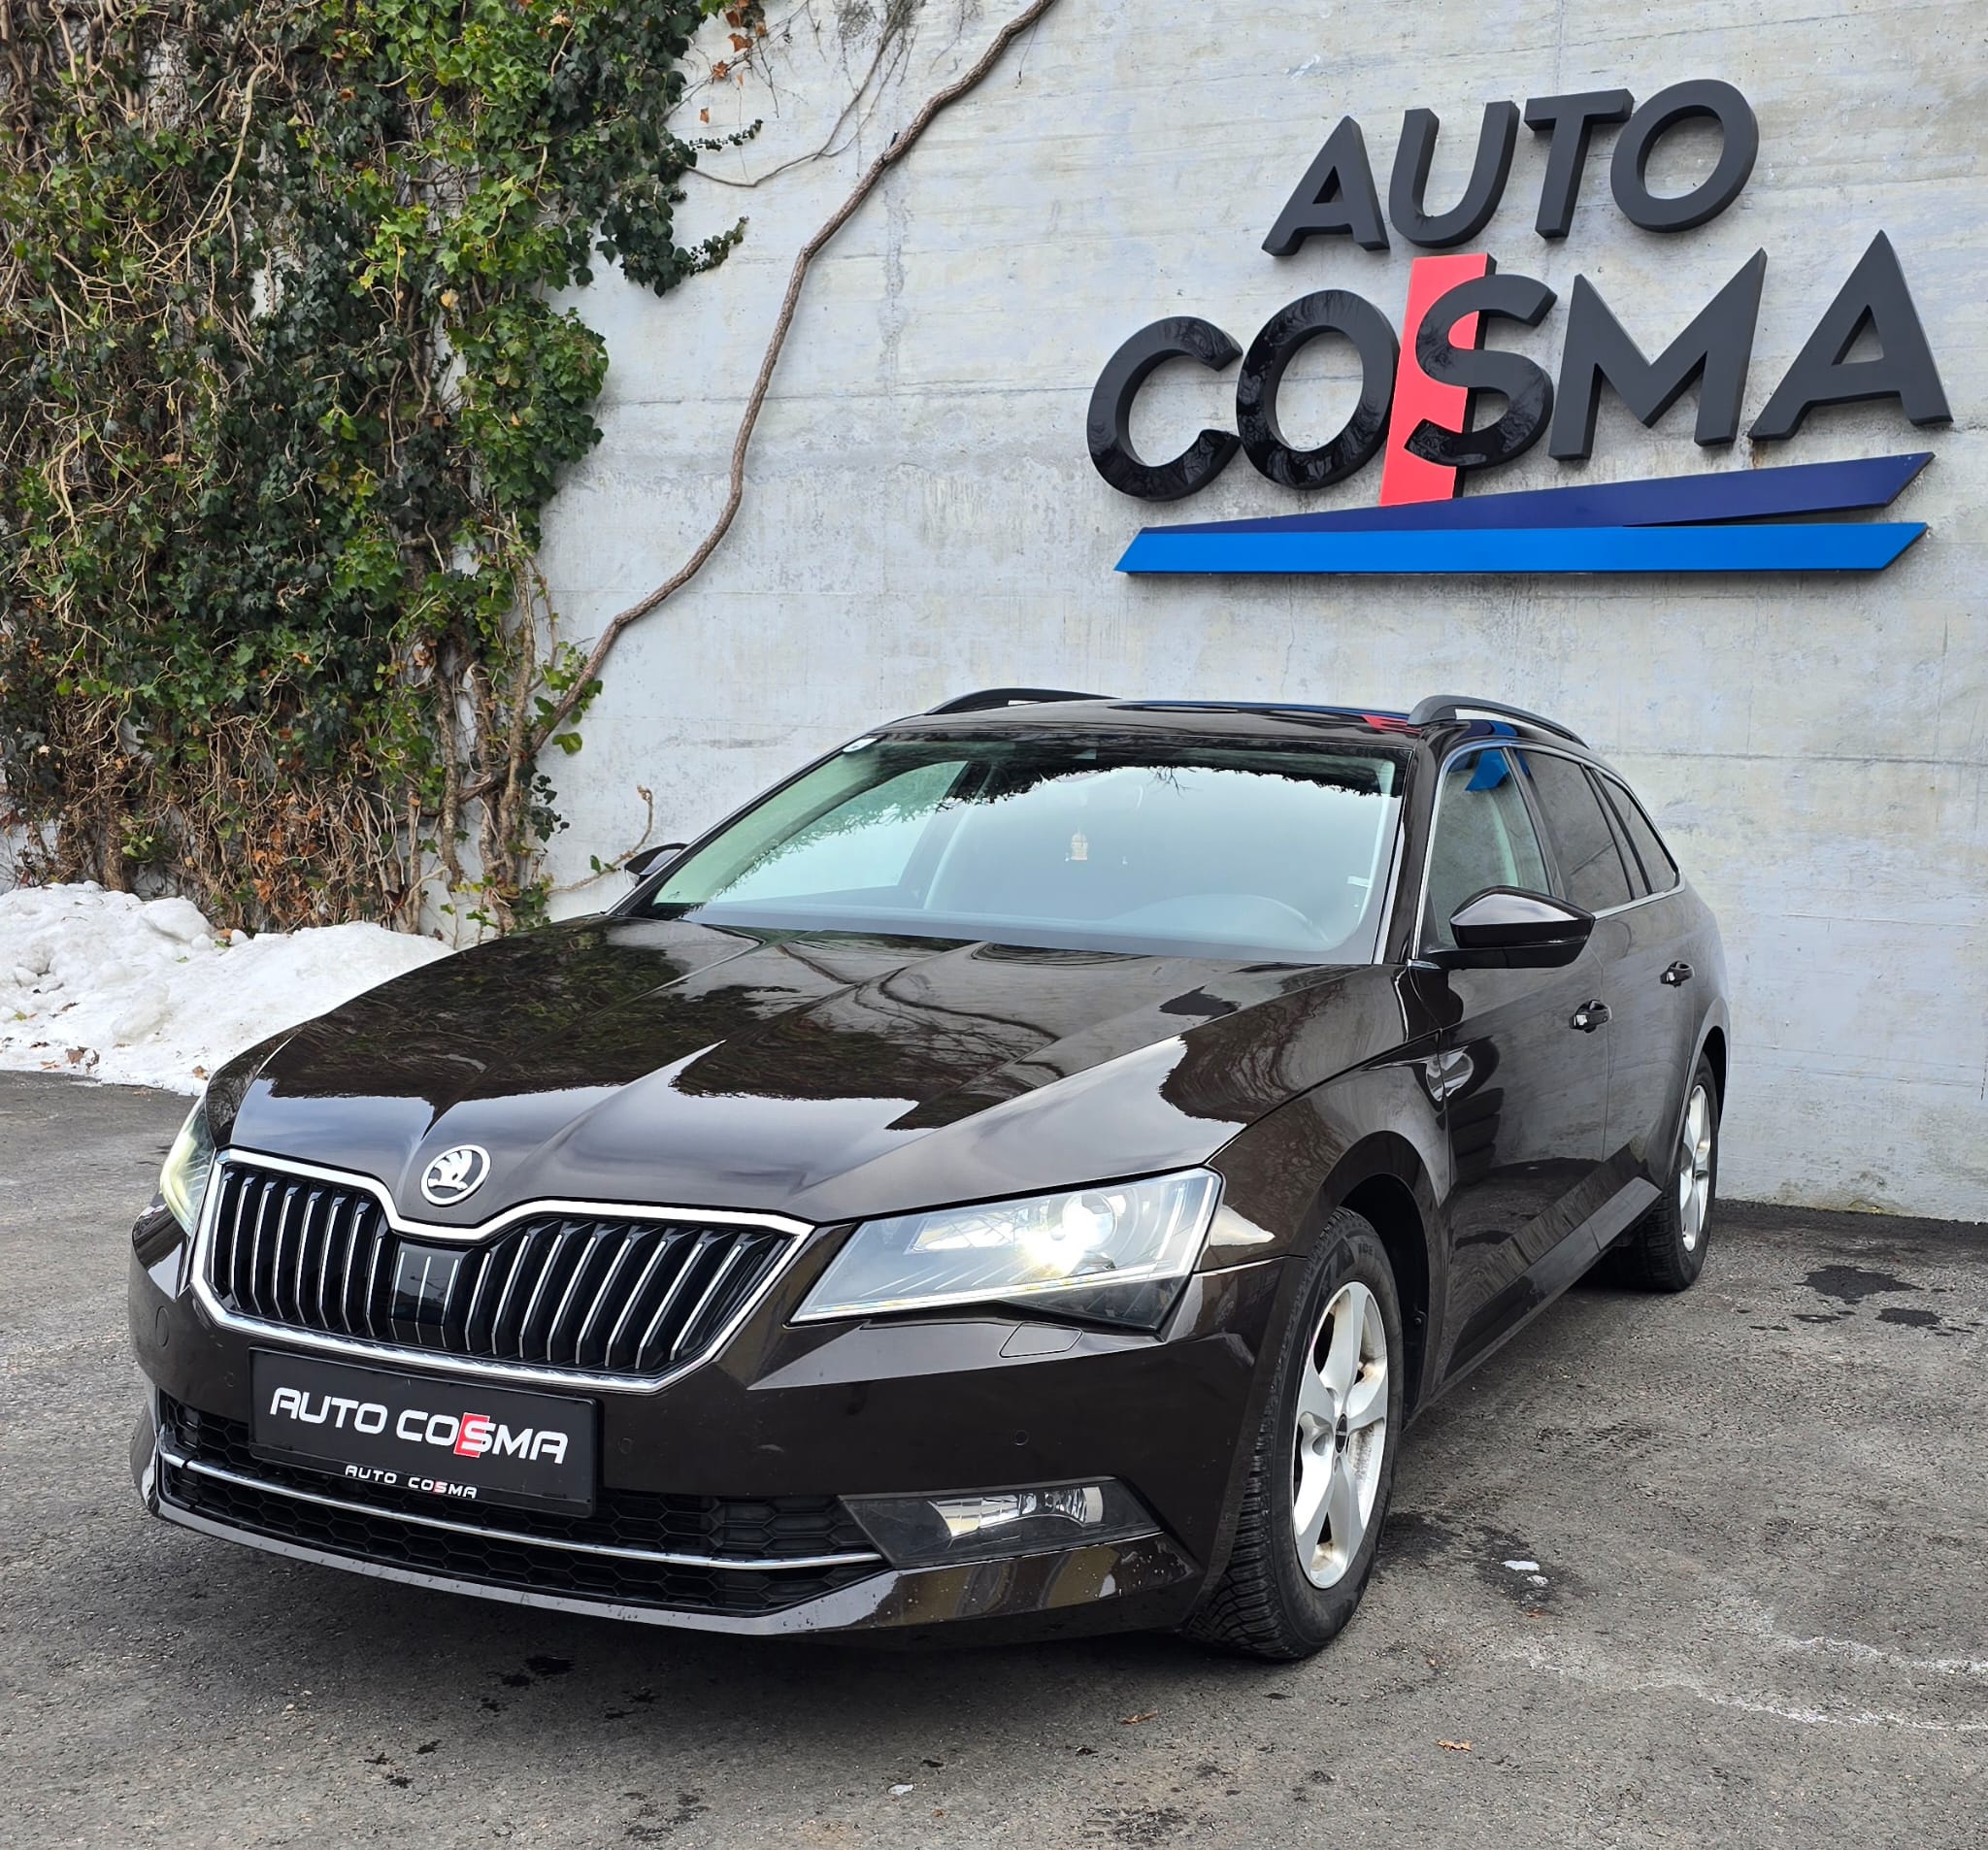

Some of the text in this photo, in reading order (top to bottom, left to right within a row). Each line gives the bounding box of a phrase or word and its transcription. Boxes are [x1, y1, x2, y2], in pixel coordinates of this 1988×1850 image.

[1262, 79, 1759, 256] AUTO
[1086, 230, 1953, 500] COSMA
[270, 1387, 569, 1464] AUTO COSMA
[345, 1465, 478, 1499] AUTO COSMA
